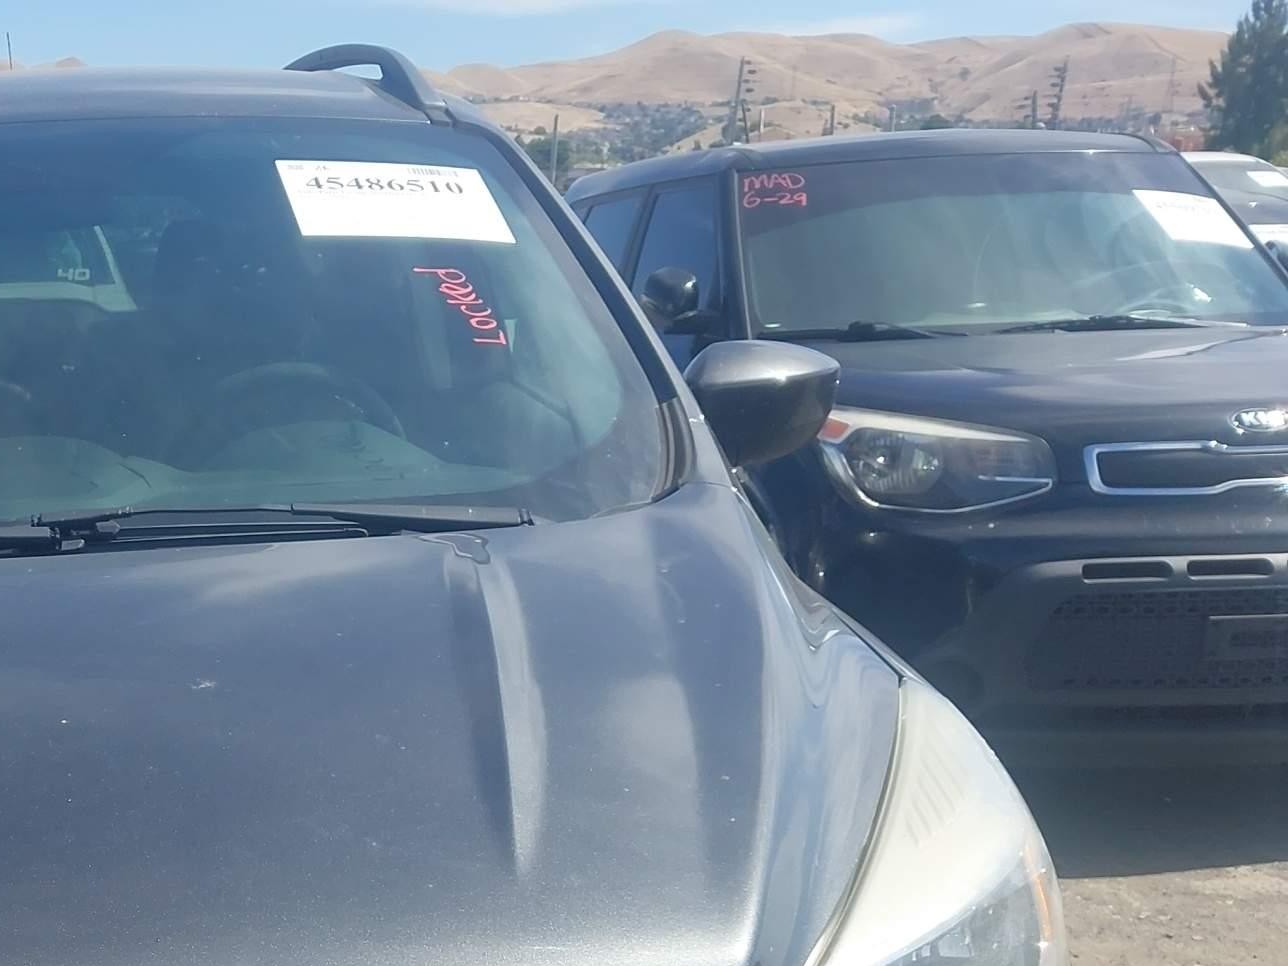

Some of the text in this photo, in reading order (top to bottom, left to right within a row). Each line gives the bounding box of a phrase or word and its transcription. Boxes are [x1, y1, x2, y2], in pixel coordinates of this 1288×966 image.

[305, 176, 463, 194] 45486510
[743, 172, 806, 193] MAD
[743, 190, 807, 208] 6-29
